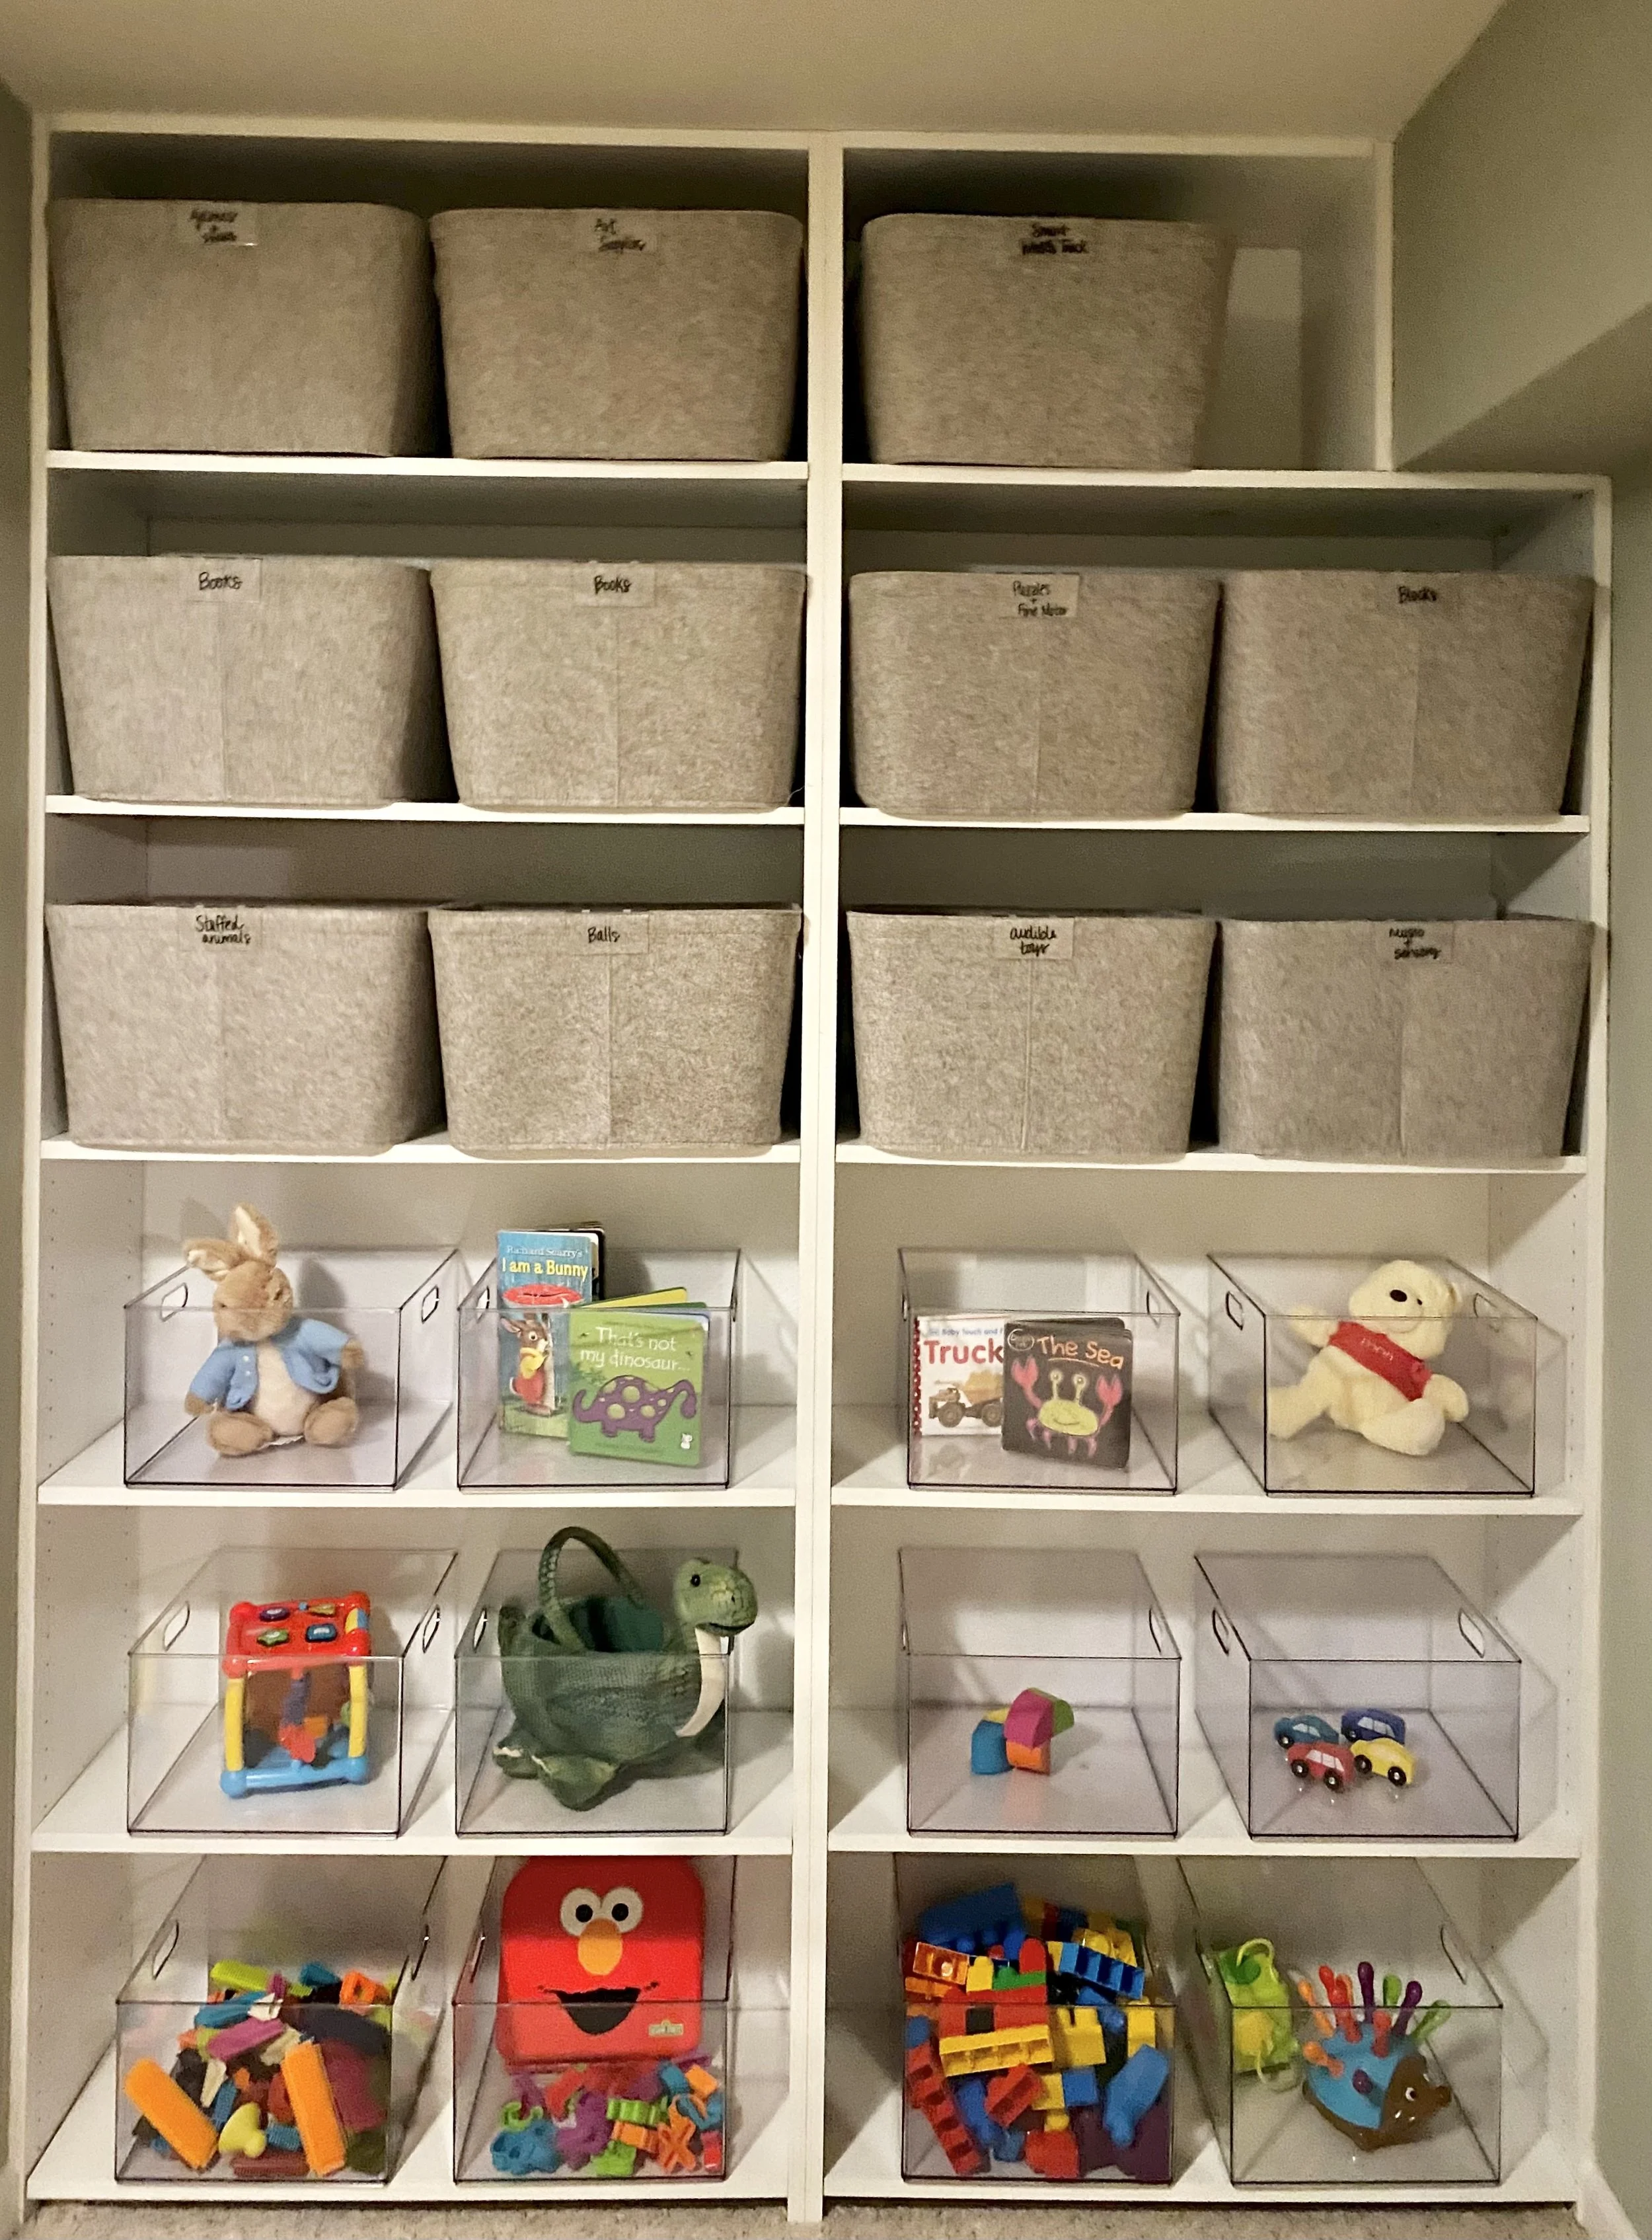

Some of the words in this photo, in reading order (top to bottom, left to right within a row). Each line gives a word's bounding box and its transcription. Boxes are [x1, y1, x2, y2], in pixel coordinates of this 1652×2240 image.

[199, 571, 243, 590] Books
[594, 574, 632, 595] Books
[196, 914, 244, 932] Stuffed
[587, 925, 620, 943] Balls
[1010, 925, 1057, 941] audible
[502, 1257, 507, 1272] I
[509, 1260, 531, 1274] am
[534, 1262, 544, 1274] a
[546, 1258, 589, 1283] Bunny
[596, 1326, 645, 1348] That's
[648, 1336, 677, 1352] not
[580, 1349, 605, 1368] my
[1036, 1334, 1078, 1356] The
[1085, 1340, 1124, 1370] Sea
